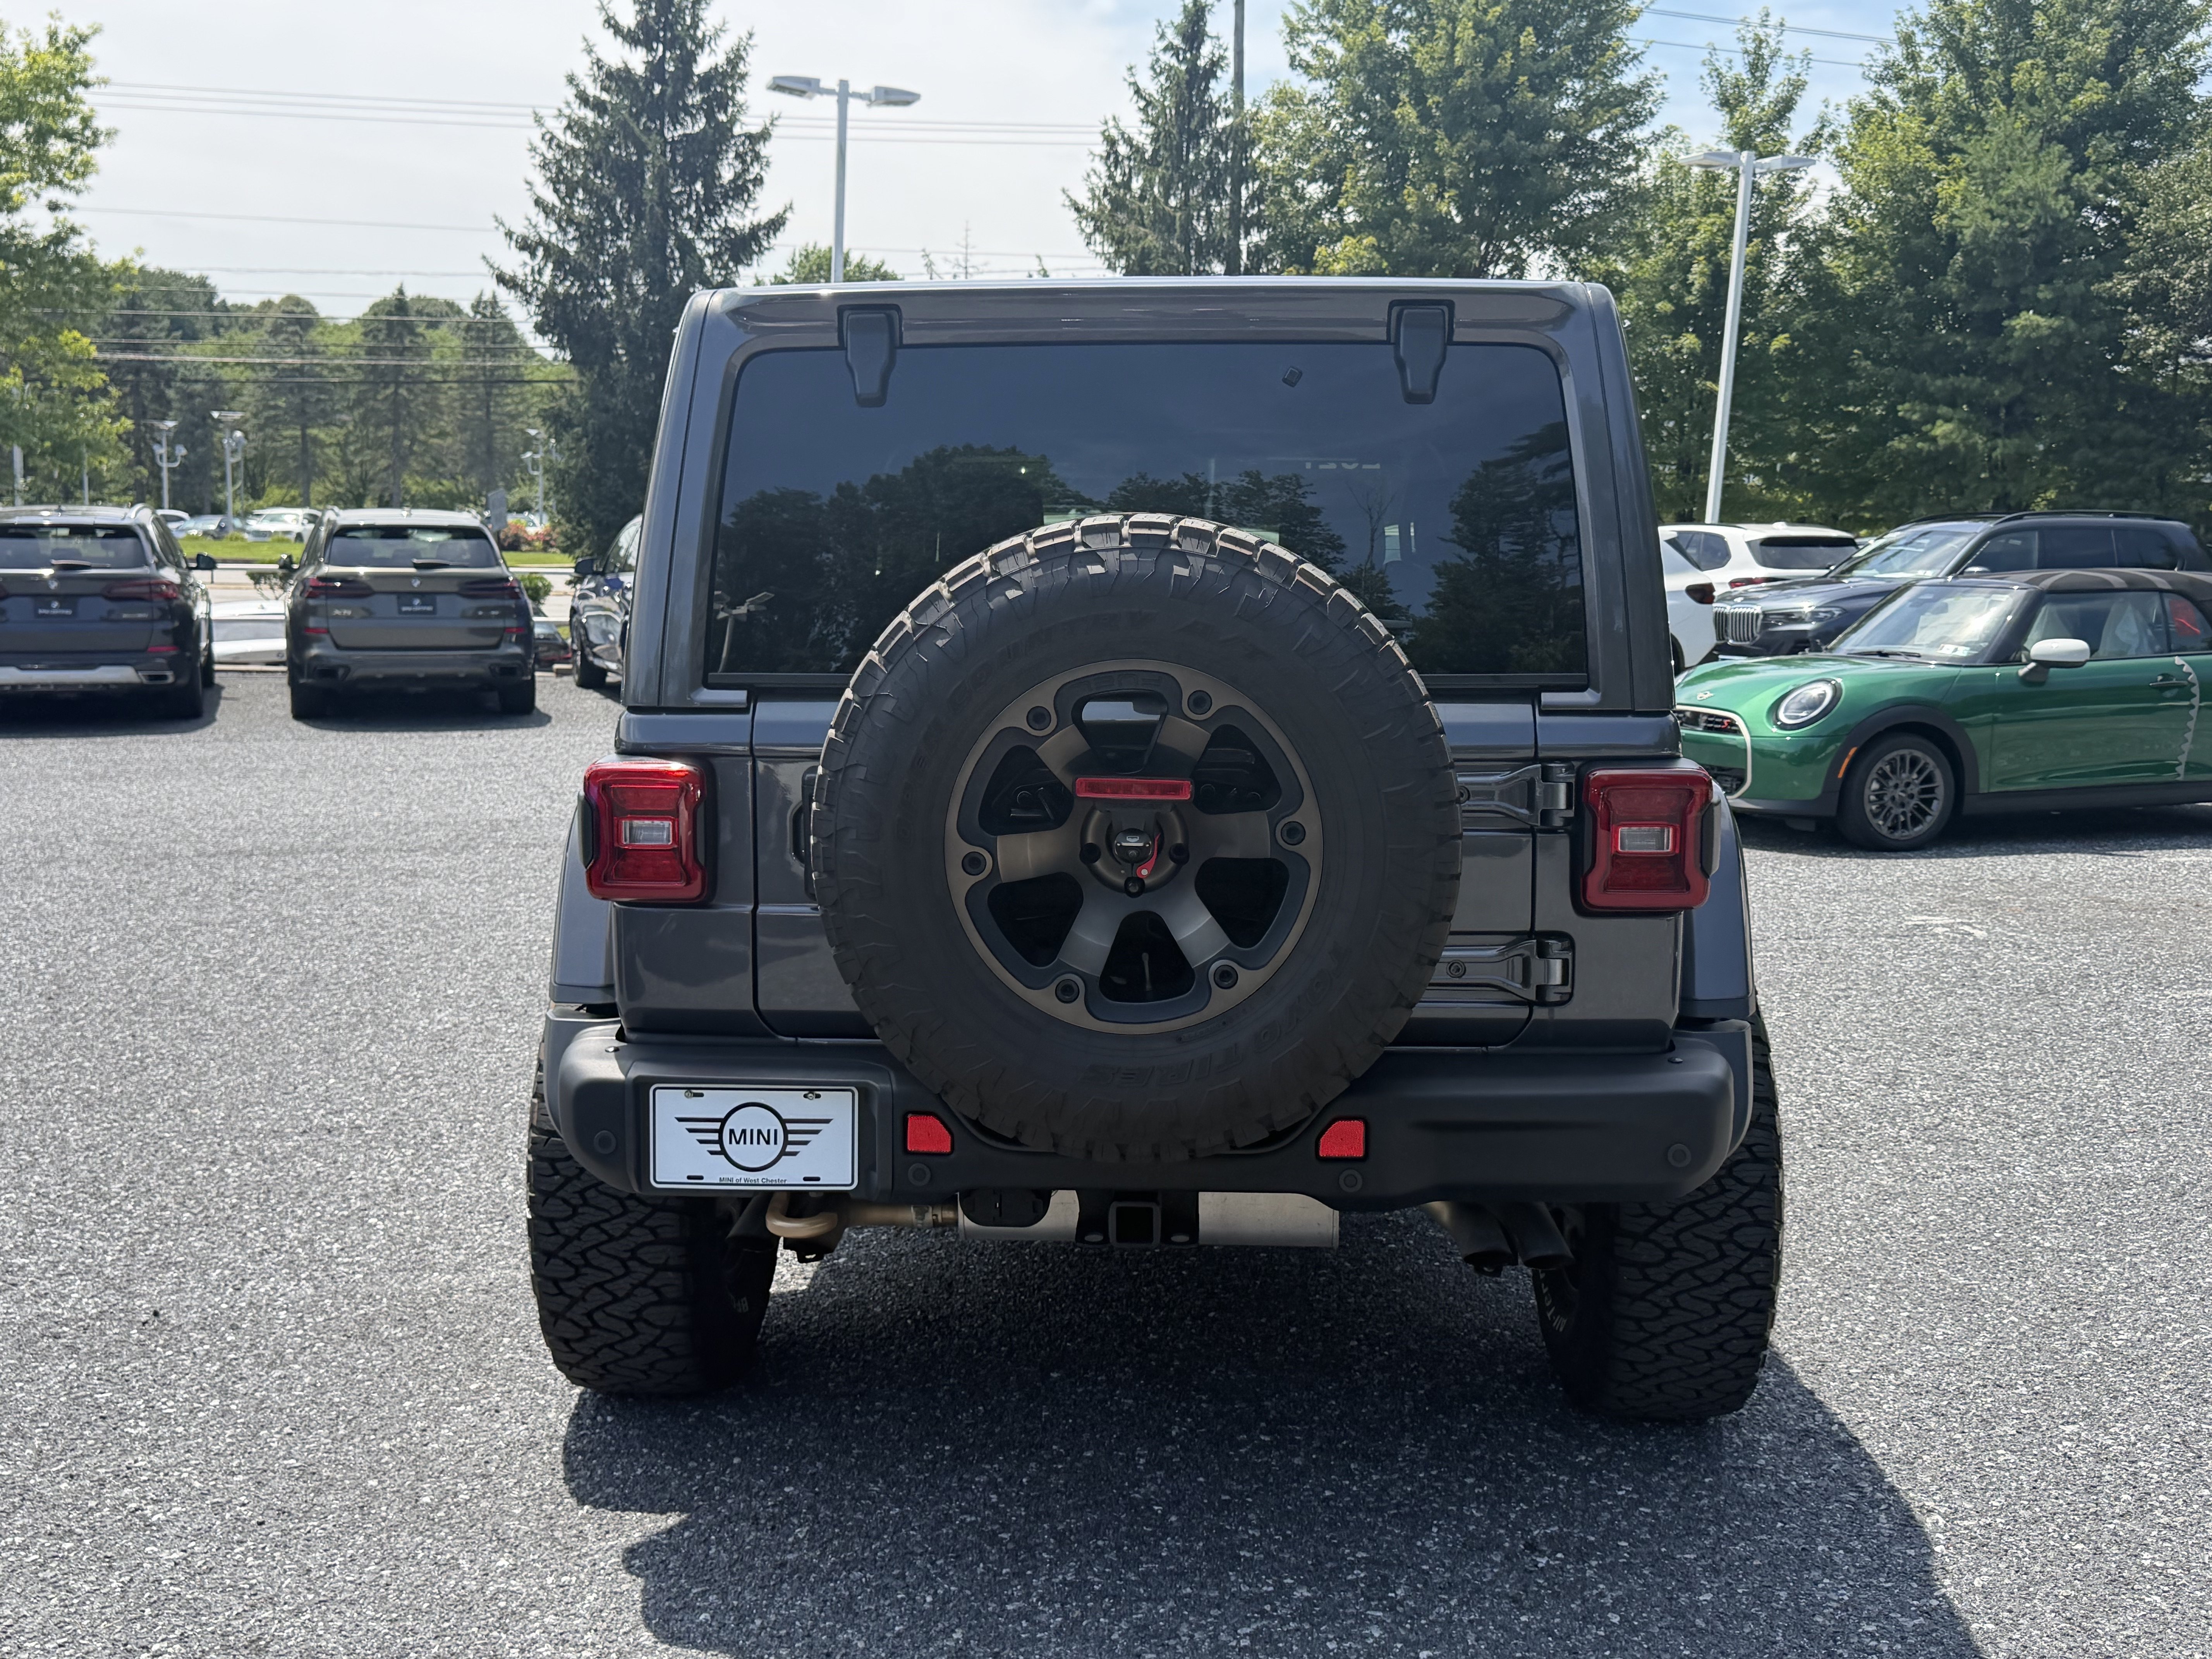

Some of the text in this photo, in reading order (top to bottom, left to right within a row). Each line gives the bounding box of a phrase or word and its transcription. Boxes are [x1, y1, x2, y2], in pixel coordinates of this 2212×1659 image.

[1068, 673, 1162, 691] FUEL
[1721, 719, 1731, 729] S
[1083, 946, 1349, 1087] TOYO TIRES
[729, 1128, 778, 1145] MINI
